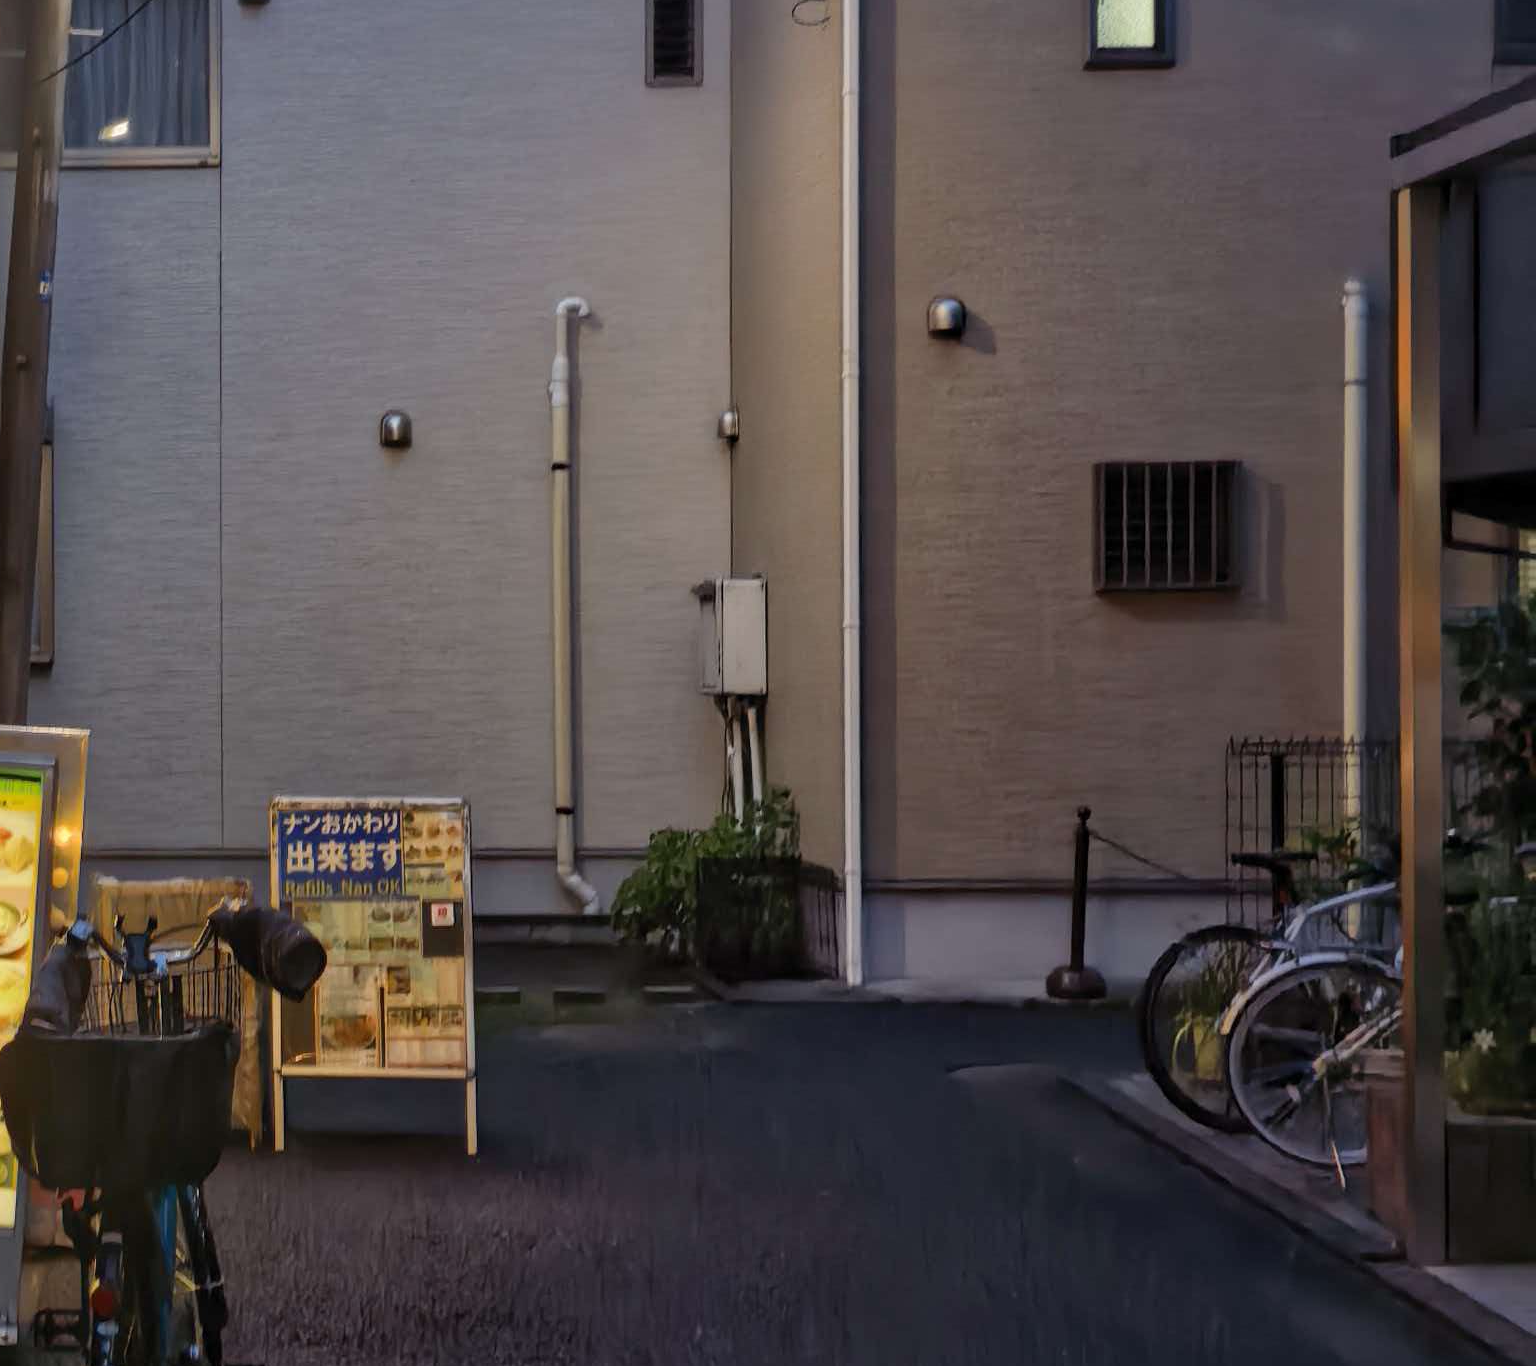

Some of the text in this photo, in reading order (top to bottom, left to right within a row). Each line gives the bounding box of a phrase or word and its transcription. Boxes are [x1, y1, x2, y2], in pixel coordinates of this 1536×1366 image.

[283, 811, 399, 835] ナンおかわり
[286, 838, 401, 874] 出来ます
